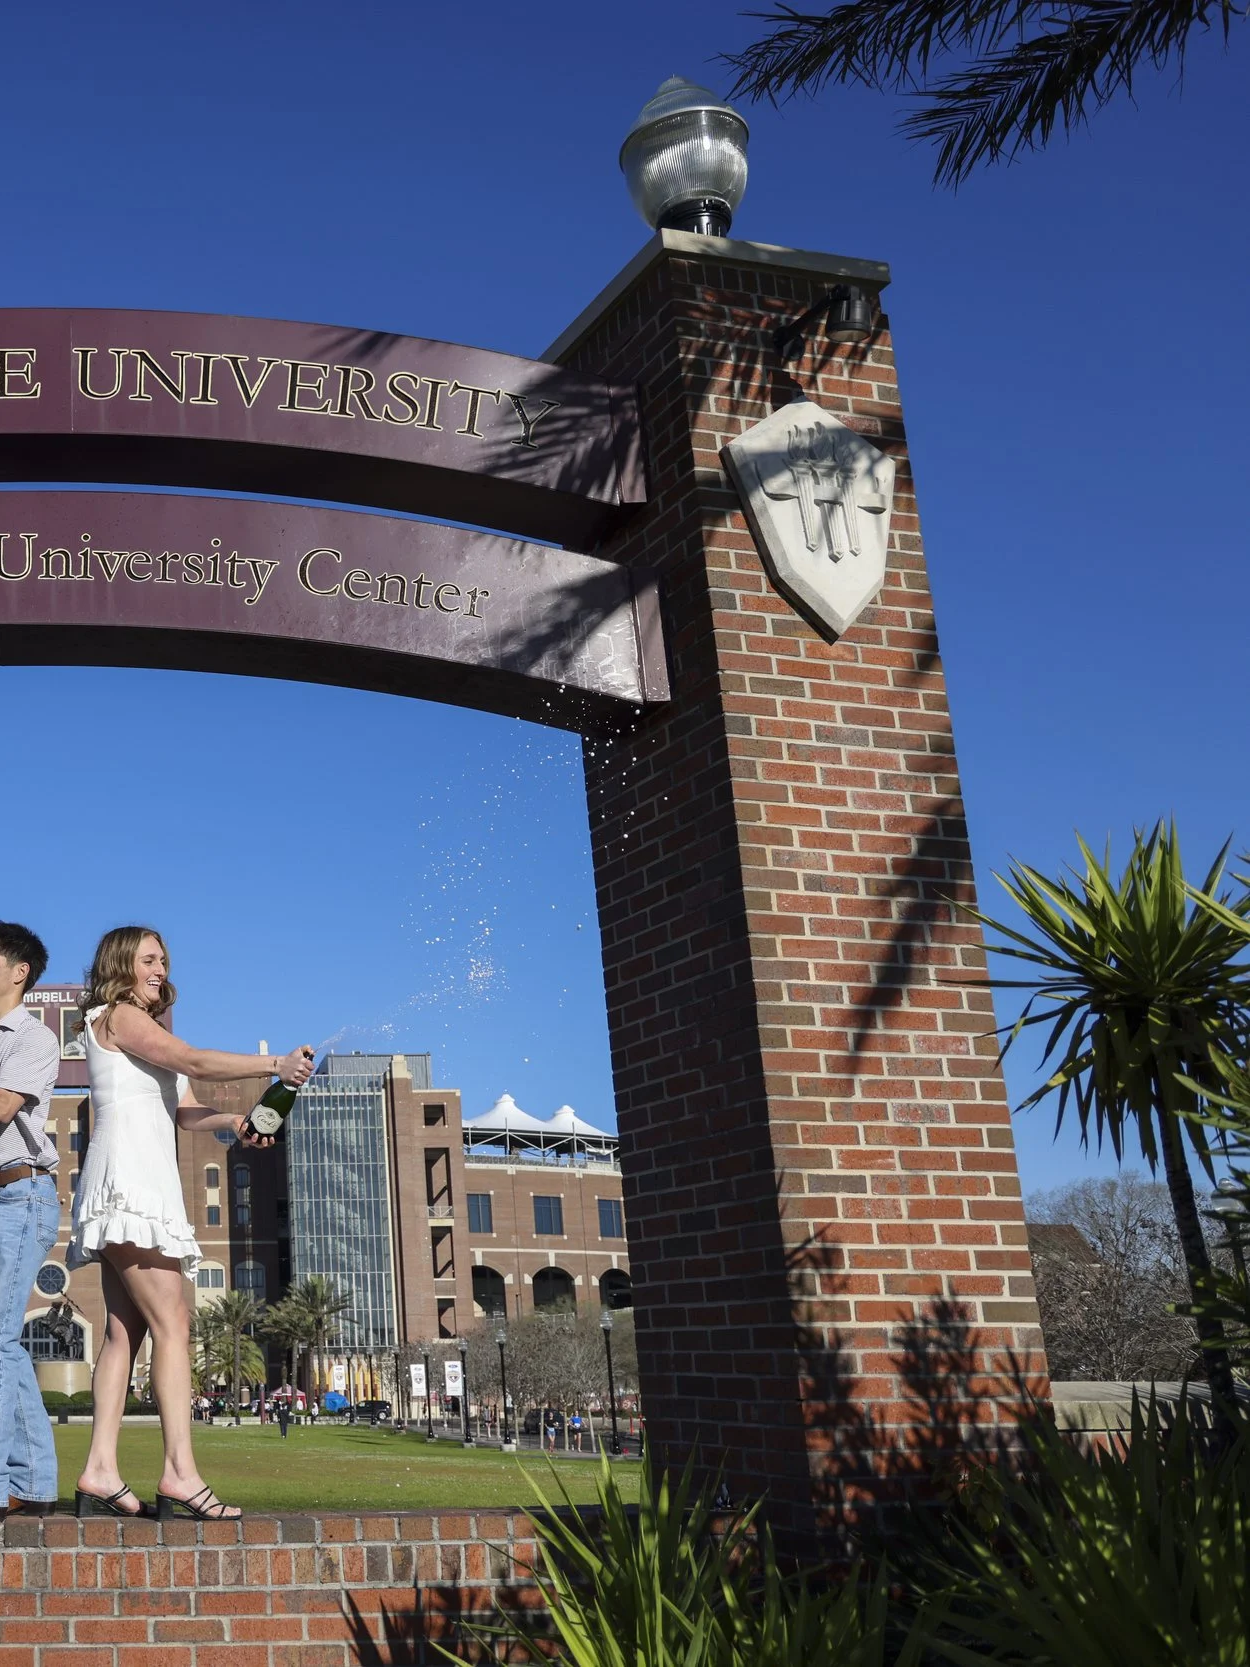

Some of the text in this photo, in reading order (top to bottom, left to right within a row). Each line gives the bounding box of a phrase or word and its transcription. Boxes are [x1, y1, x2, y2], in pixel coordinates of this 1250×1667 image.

[72, 347, 560, 449] UNIVERSITY
[297, 547, 490, 619] Center
[23, 992, 74, 1003] MPBELL
